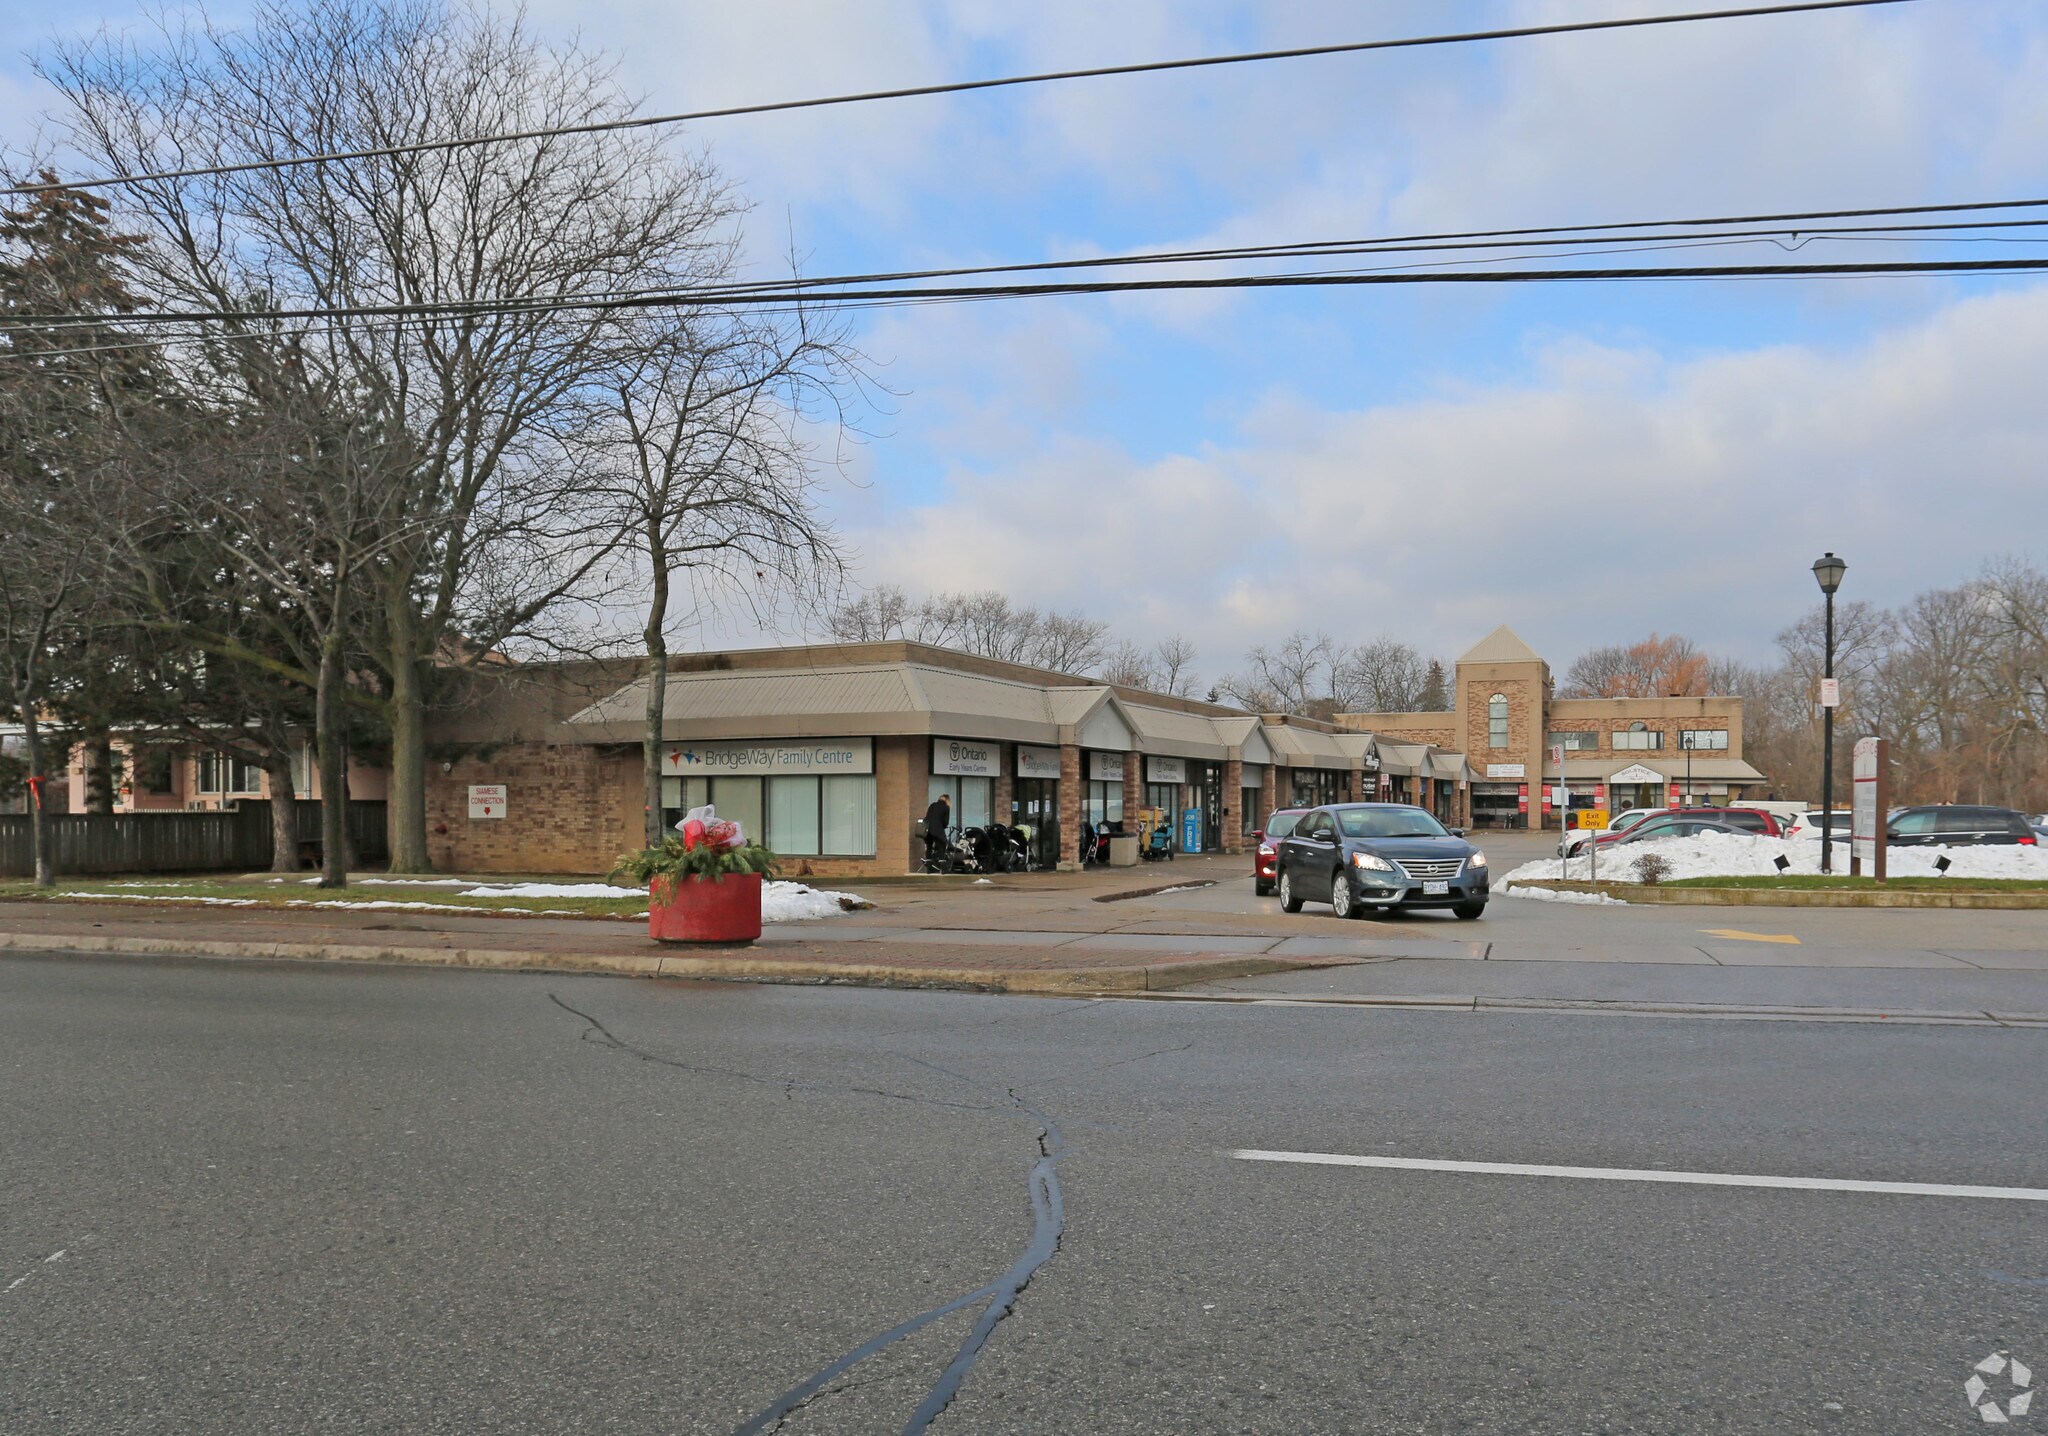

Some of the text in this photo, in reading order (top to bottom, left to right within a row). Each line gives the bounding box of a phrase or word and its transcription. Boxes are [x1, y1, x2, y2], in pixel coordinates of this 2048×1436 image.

[1695, 730, 1727, 741] LAW
[961, 746, 987, 761] Ontario
[705, 749, 853, 769] BridgeWay Family Centre
[949, 763, 987, 773] Early Years Centre
[475, 787, 499, 795] SIAMESE
[470, 797, 505, 805] CONNECTION
